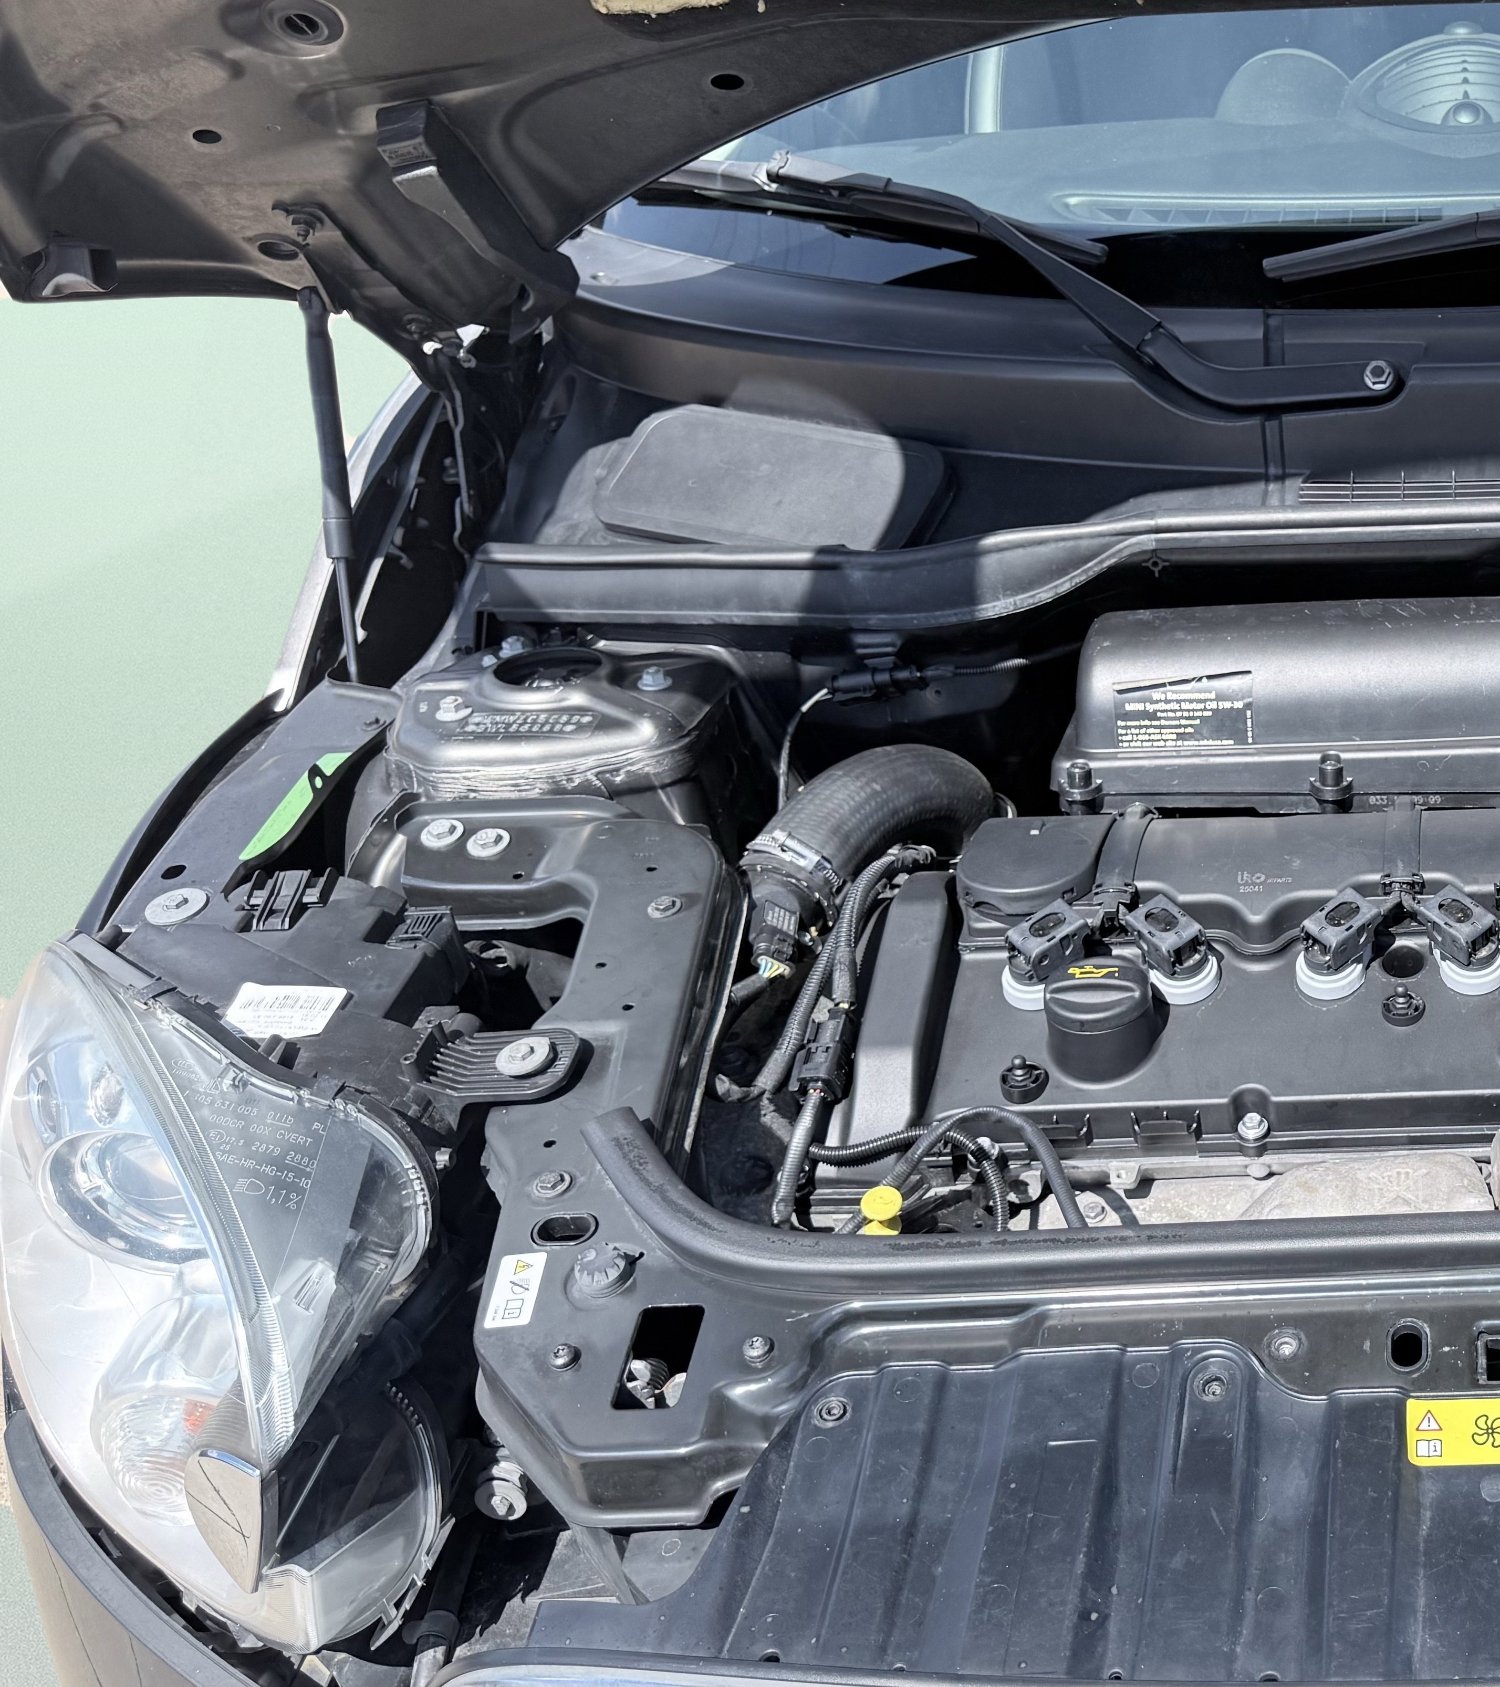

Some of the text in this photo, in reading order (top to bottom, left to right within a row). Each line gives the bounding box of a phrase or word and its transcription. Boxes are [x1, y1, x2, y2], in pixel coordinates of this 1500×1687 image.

[1152, 691, 1215, 700] We Recommend
[1145, 703, 1180, 712] Synthetic
[312, 1122, 326, 1134] PL
[276, 1130, 312, 1146] CVERT
[252, 1142, 281, 1156] 2879
[286, 1152, 317, 1168] 2880
[215, 1151, 311, 1188] SAE-HR-HG-15-10
